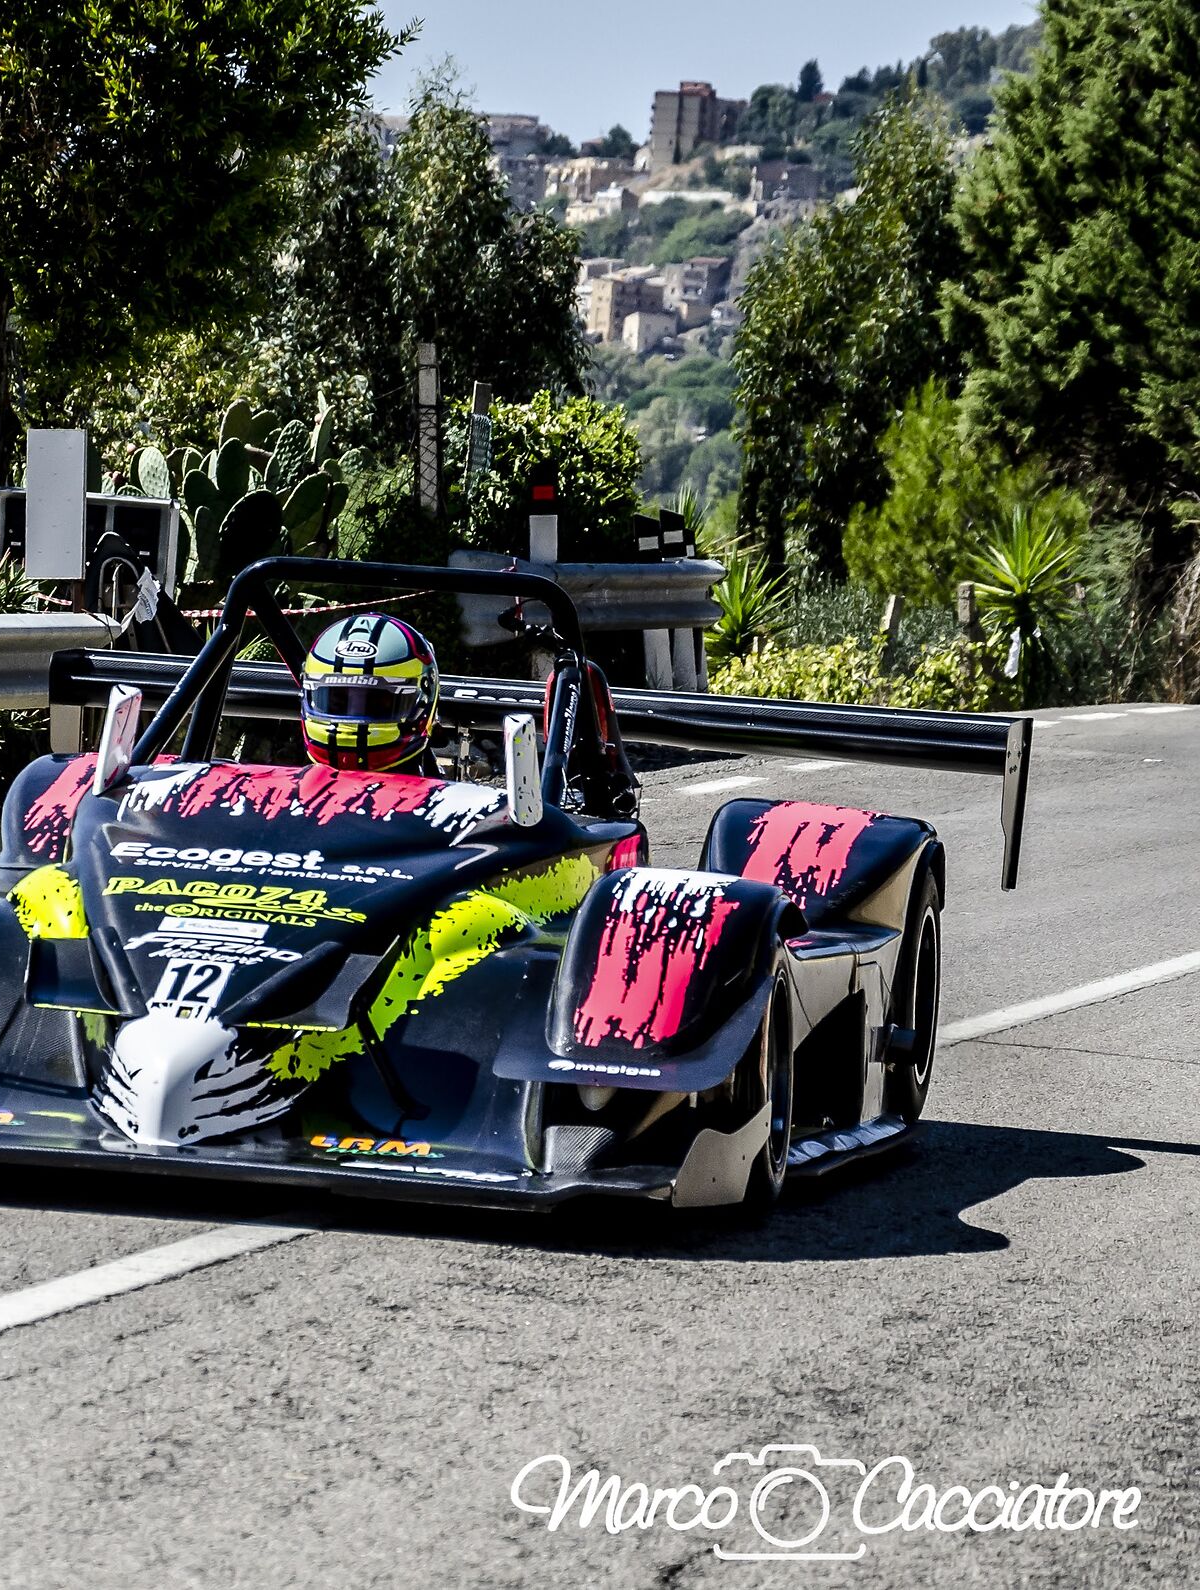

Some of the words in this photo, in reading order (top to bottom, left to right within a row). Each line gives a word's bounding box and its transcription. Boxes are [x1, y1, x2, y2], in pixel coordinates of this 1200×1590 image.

[340, 641, 371, 654] Arai
[109, 841, 325, 871] Ecogest
[341, 864, 414, 880] S.R.L.
[133, 858, 209, 870] Servizi
[258, 867, 378, 884] l'ambiente
[165, 962, 223, 1004] 12
[309, 1135, 432, 1156] LRM
